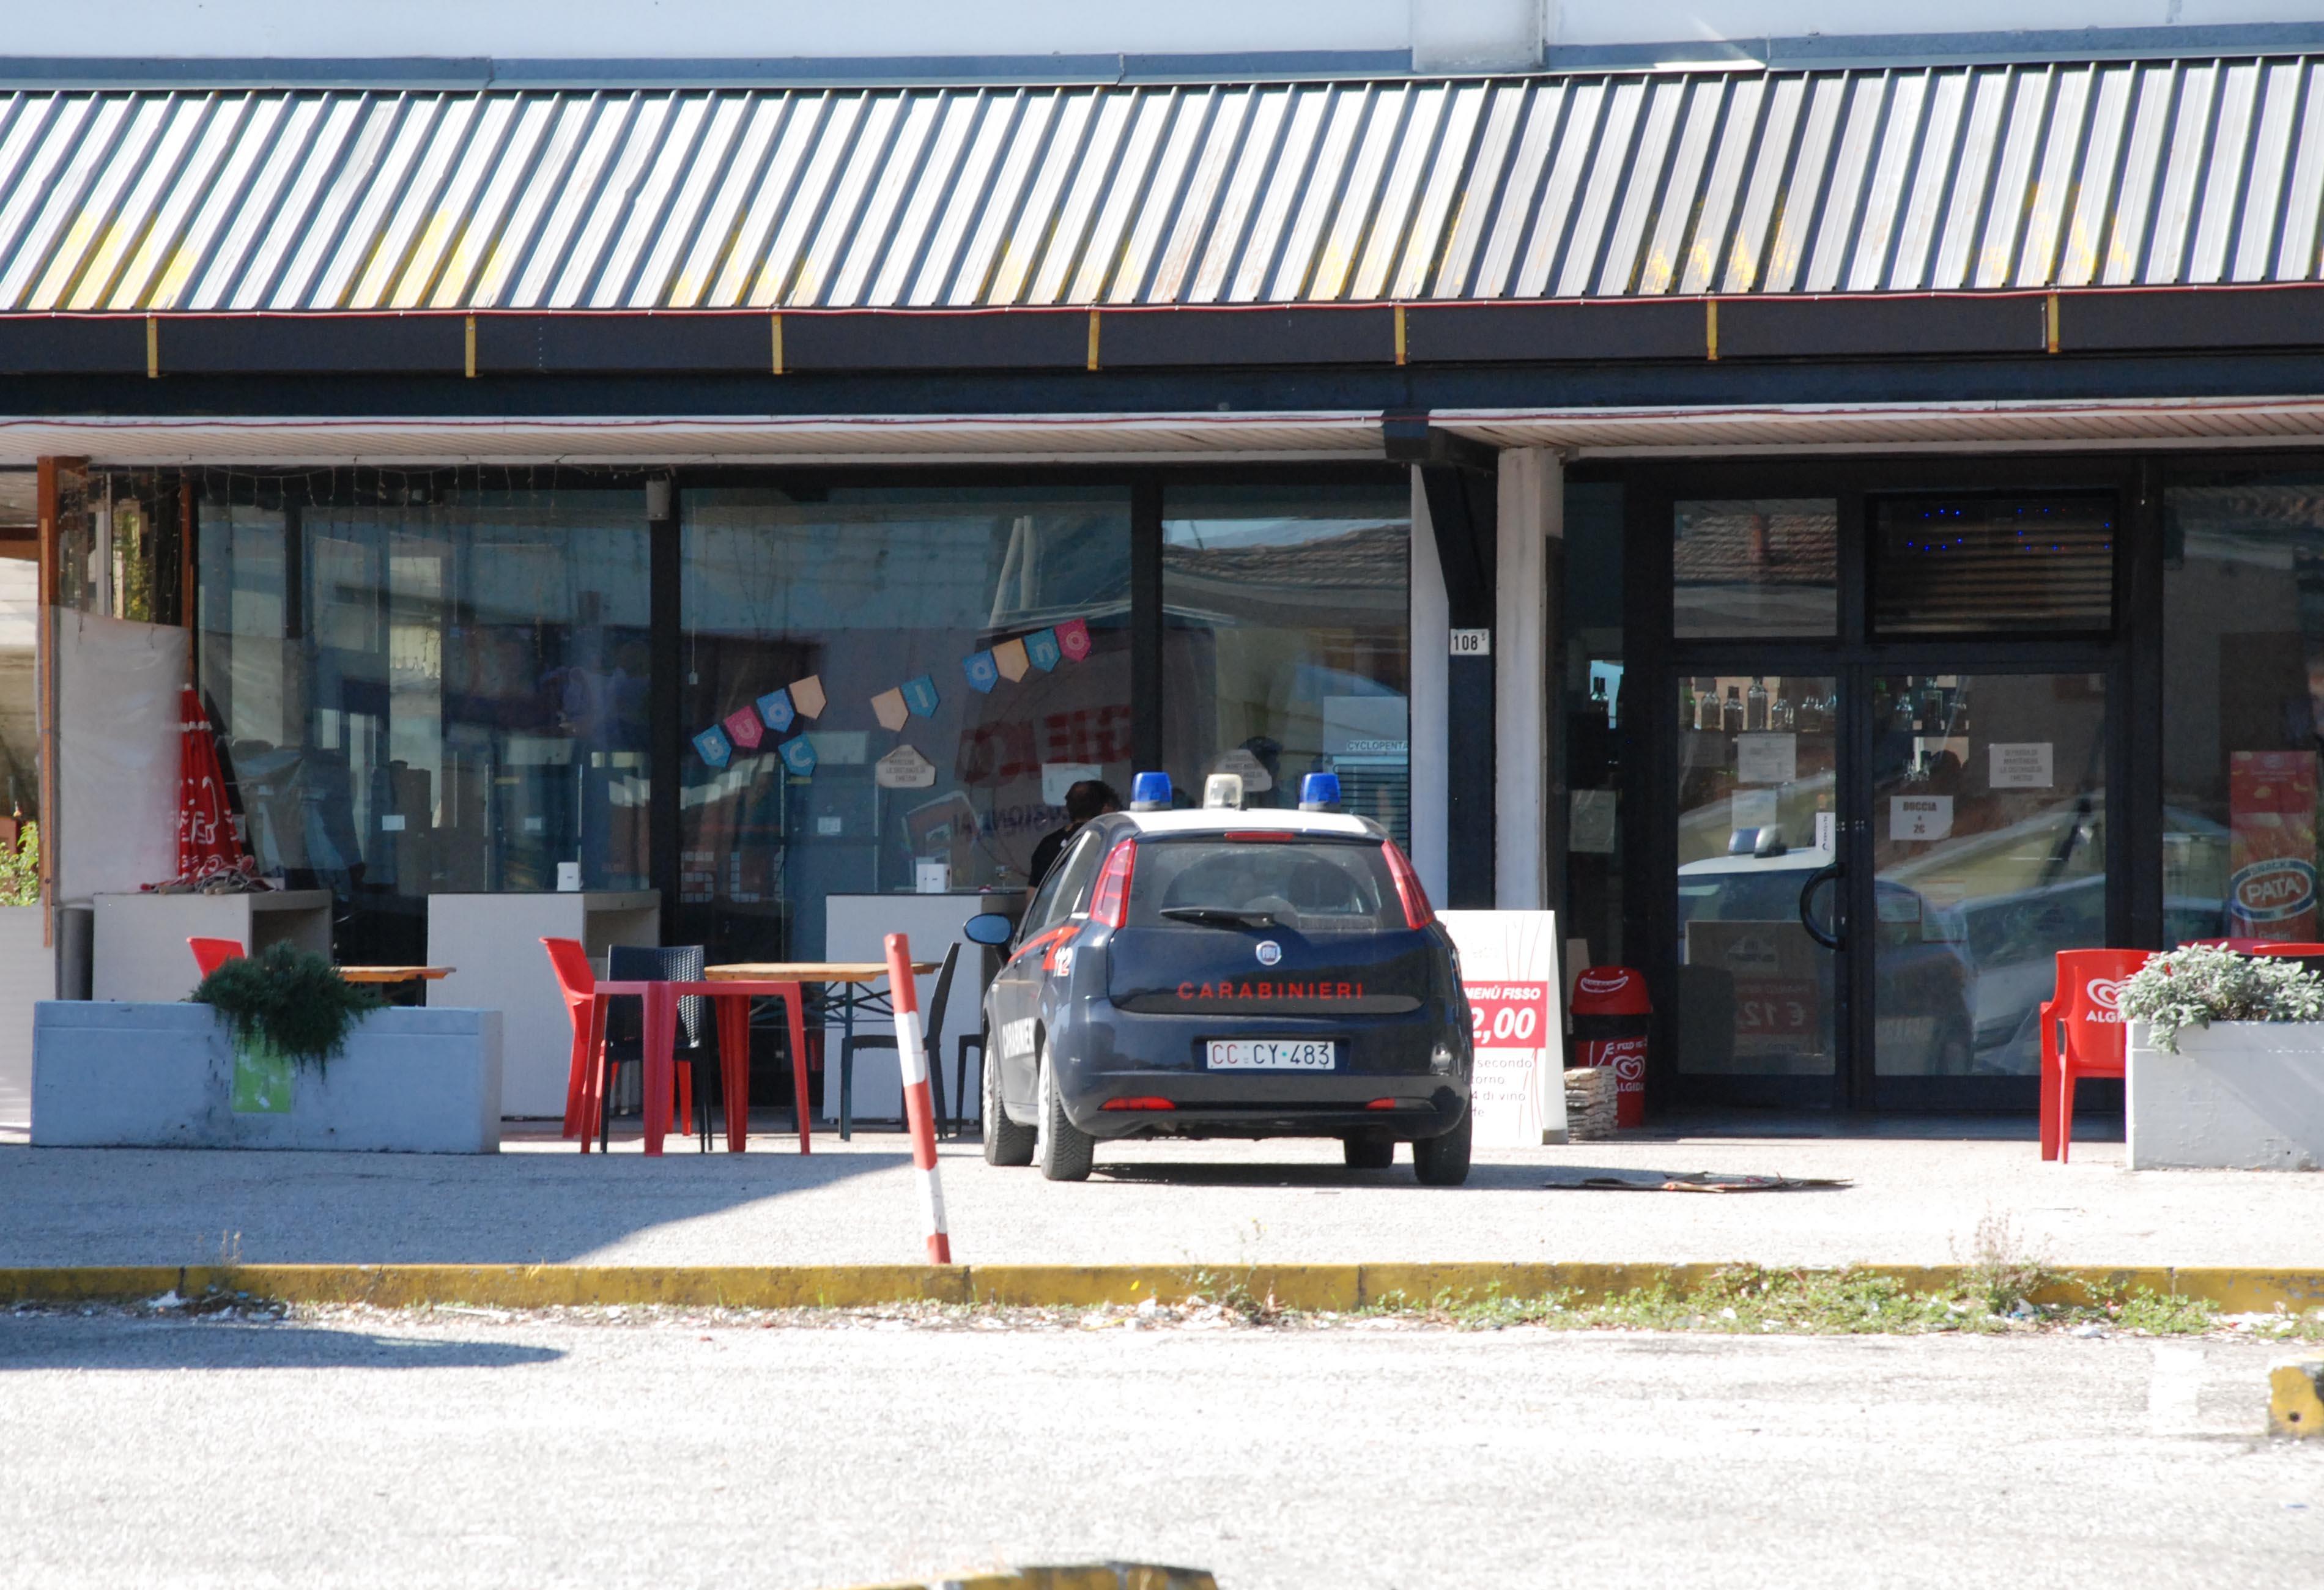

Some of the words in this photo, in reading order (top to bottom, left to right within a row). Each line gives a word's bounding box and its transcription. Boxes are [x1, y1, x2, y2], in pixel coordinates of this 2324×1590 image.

[1454, 635, 1478, 651] 108
[2246, 877, 2301, 904] PATA
[1177, 982, 1363, 999] CARABINIERI
[1502, 987, 1541, 1000] FISSO
[1471, 1007, 1536, 1044] 2,00
[1212, 1044, 1238, 1065] CC
[1254, 1044, 1278, 1065] CY
[1290, 1044, 1330, 1065] 483
[1477, 1057, 1532, 1068] secondo
[1483, 1092, 1493, 1101] di
[1500, 1092, 1526, 1101] vino
